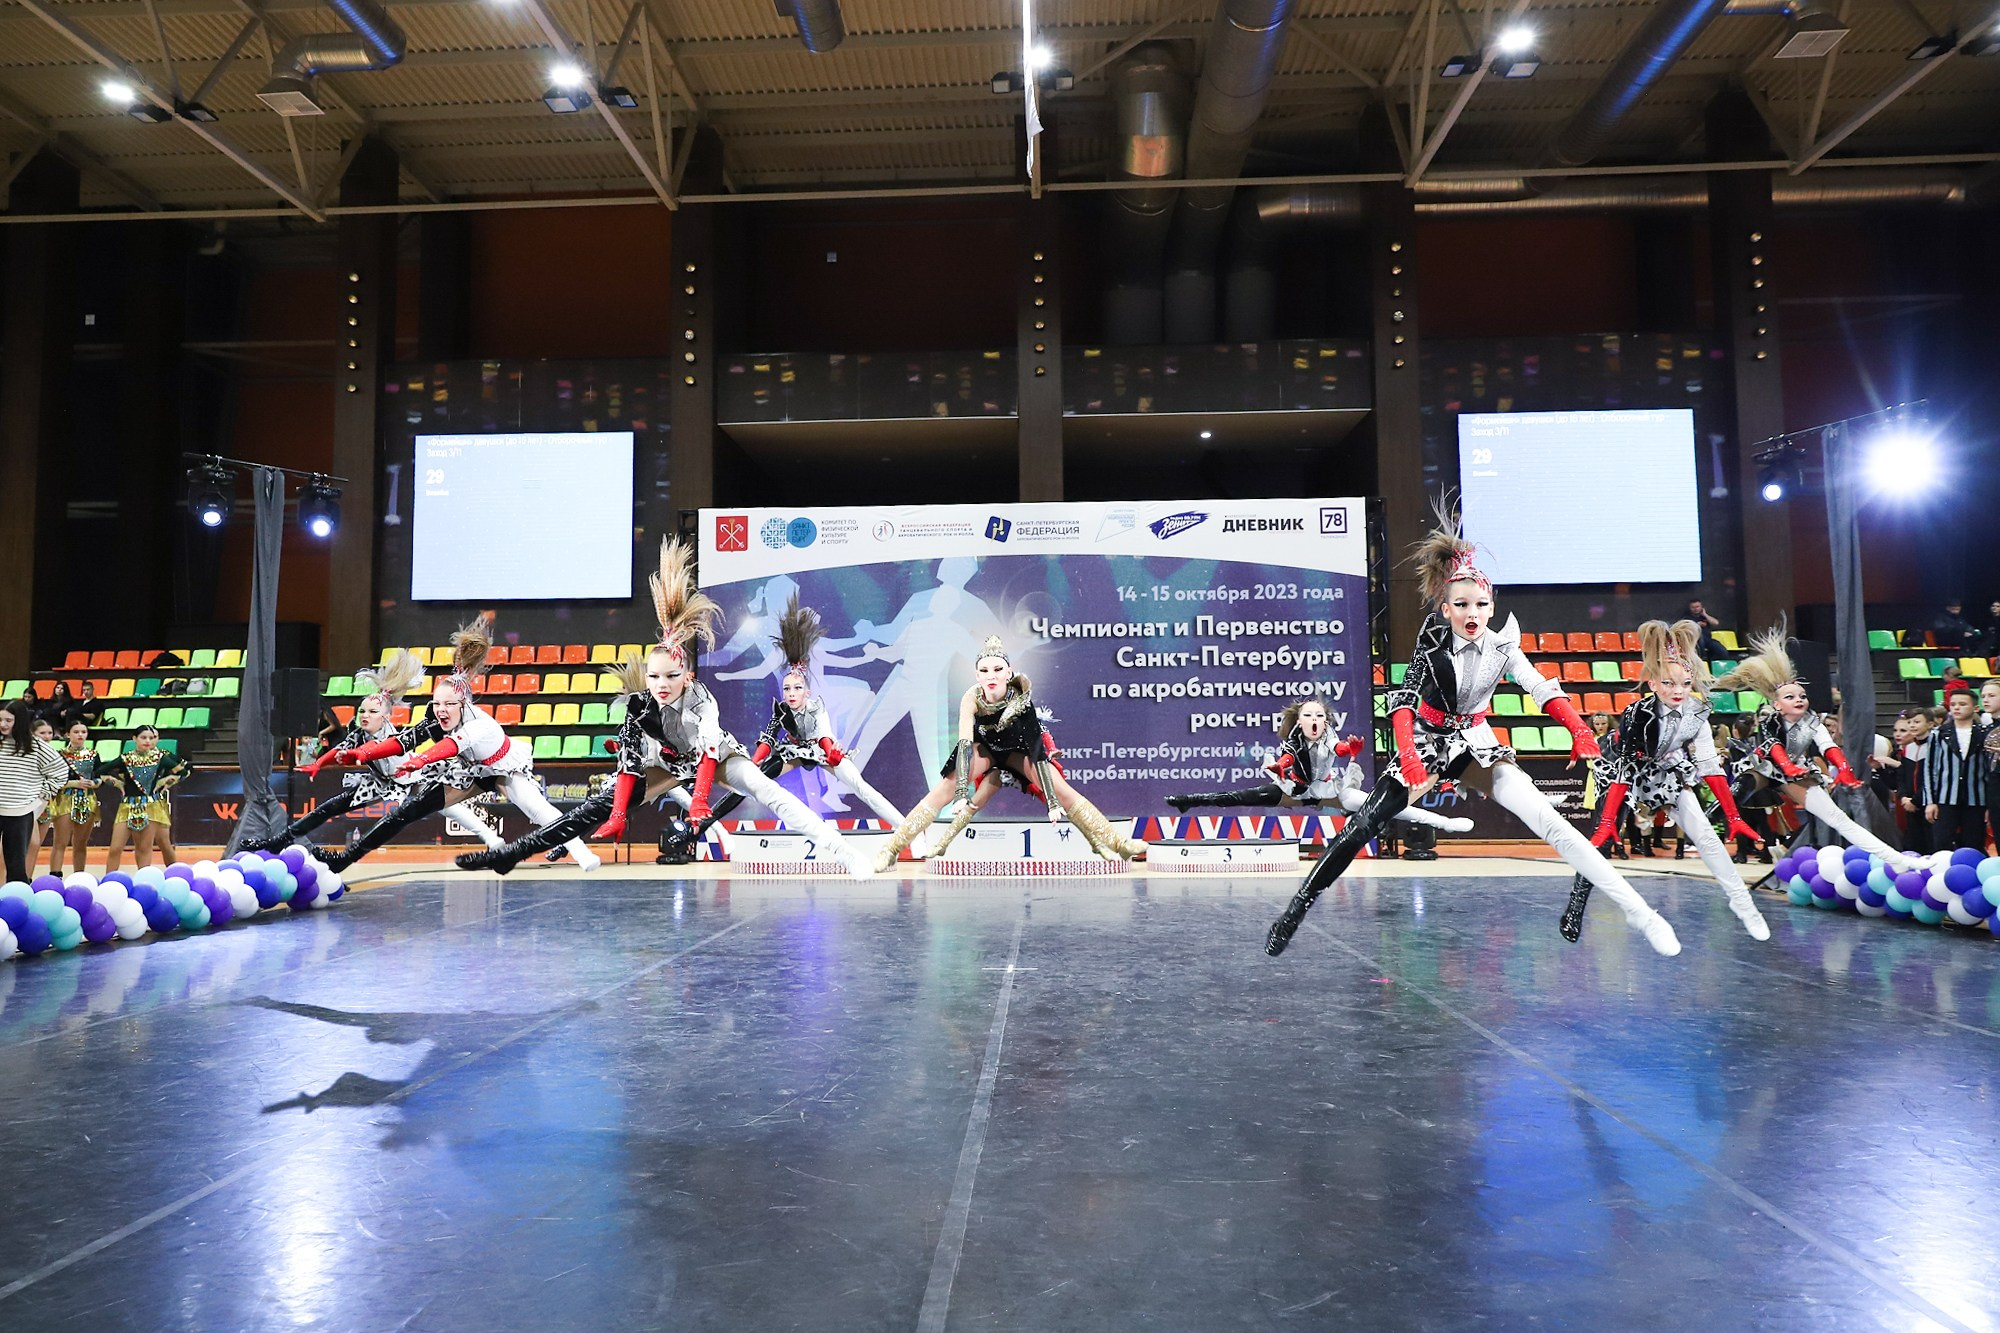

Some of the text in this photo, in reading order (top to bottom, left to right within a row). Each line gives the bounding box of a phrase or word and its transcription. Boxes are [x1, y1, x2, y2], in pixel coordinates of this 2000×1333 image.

[1472, 448, 1492, 464] 29
[426, 468, 445, 485] 29
[1016, 526, 1080, 536] ФЕДЕРАЦИЯ
[1222, 518, 1304, 533] ДНЕВНИК
[1324, 512, 1343, 529] 78
[1117, 586, 1137, 602] 14
[1151, 585, 1170, 601] 15
[1174, 585, 1249, 604] октября
[1254, 583, 1298, 600] 2023
[1302, 586, 1344, 601] года
[1031, 615, 1345, 642] Чемпионат и Первенство
[1117, 646, 1346, 671] Санкт-Петербурга
[1092, 677, 1347, 702] по акробатическому
[1190, 711, 1348, 733] рок-н-ру
[1061, 740, 1245, 762] нкт-Петербургский
[804, 839, 817, 860] 2
[1020, 828, 1032, 857] 1
[1223, 847, 1232, 862] 3
